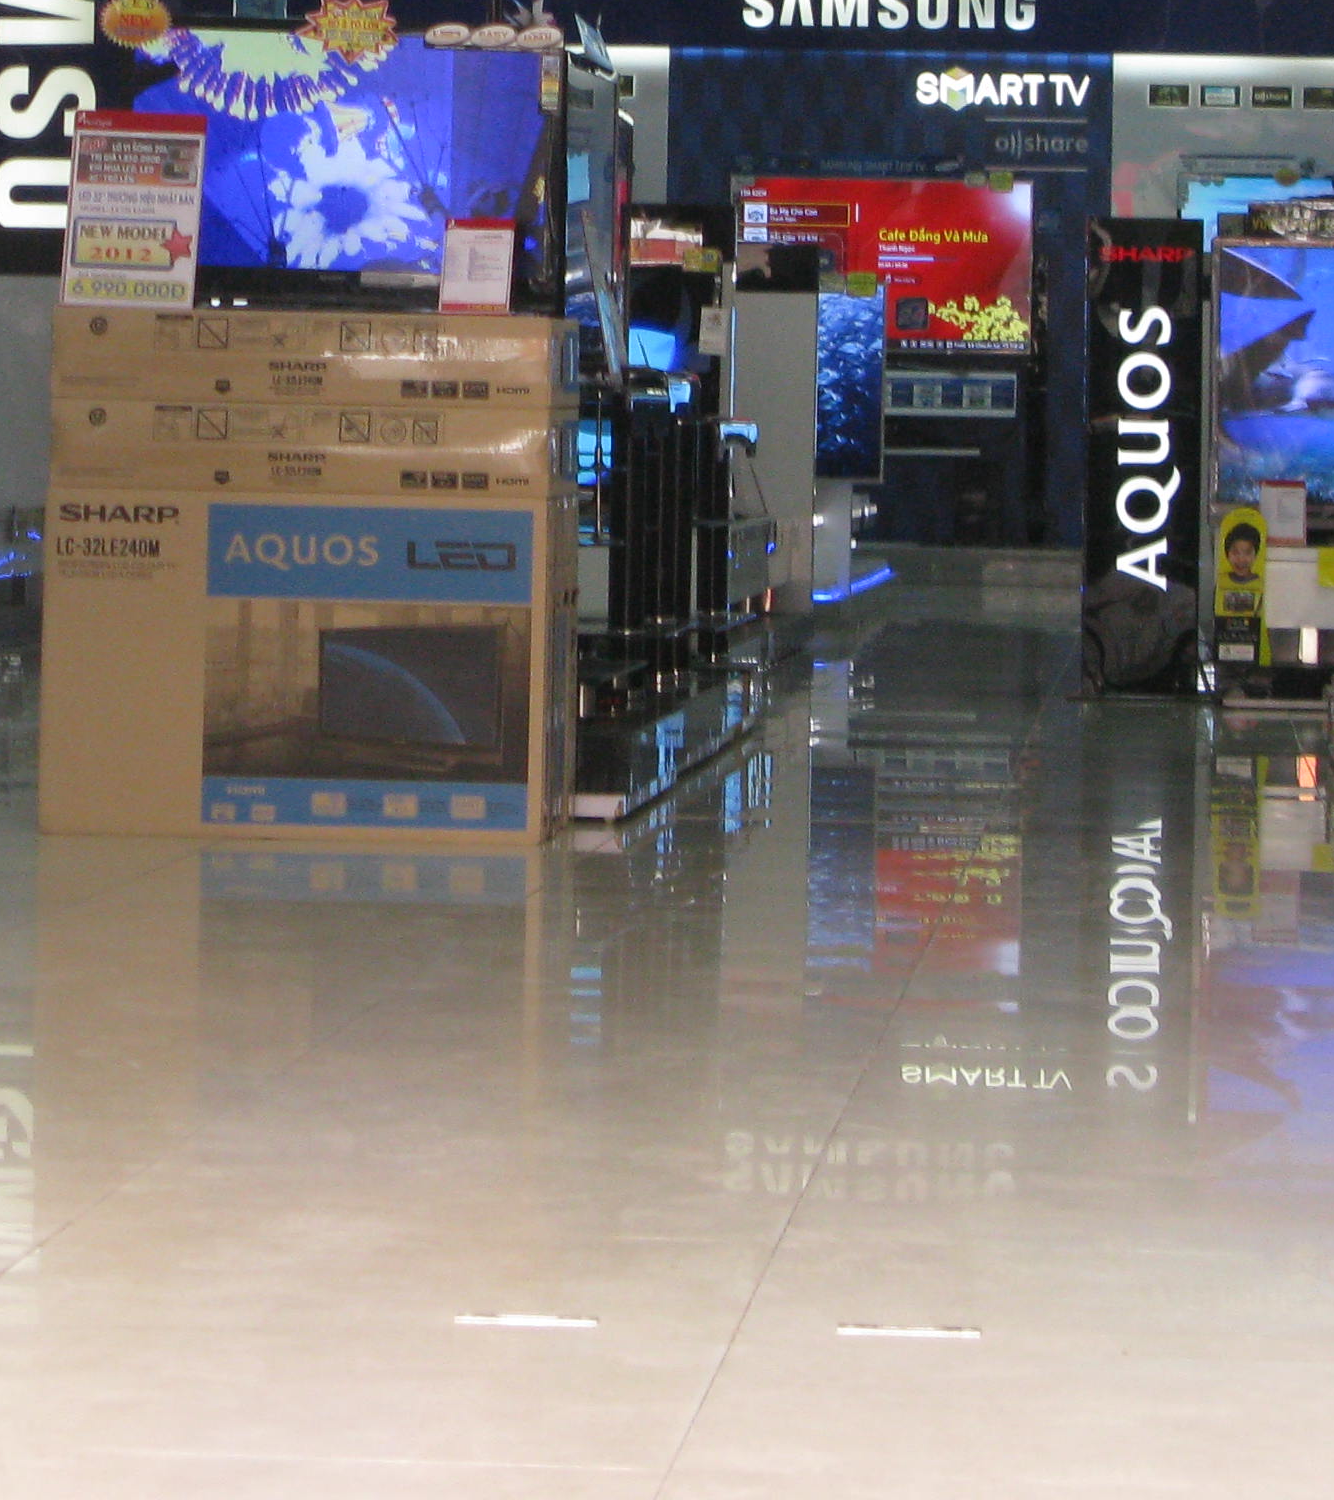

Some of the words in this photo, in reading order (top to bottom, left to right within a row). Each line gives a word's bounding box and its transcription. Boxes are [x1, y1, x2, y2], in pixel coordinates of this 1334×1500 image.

[1050, 75, 1091, 106] TV
[79, 224, 113, 238] NEW
[117, 225, 166, 240] MODEL
[878, 230, 907, 242] Cafe
[90, 247, 152, 262] 2012
[269, 361, 327, 373] SHARP
[268, 452, 327, 464] SHARP
[1114, 304, 1182, 593] AQUOS
[59, 501, 180, 525] SHARP
[56, 535, 161, 558] LC-32LE240M
[224, 533, 380, 572] AQUOS
[405, 539, 518, 573] LED
